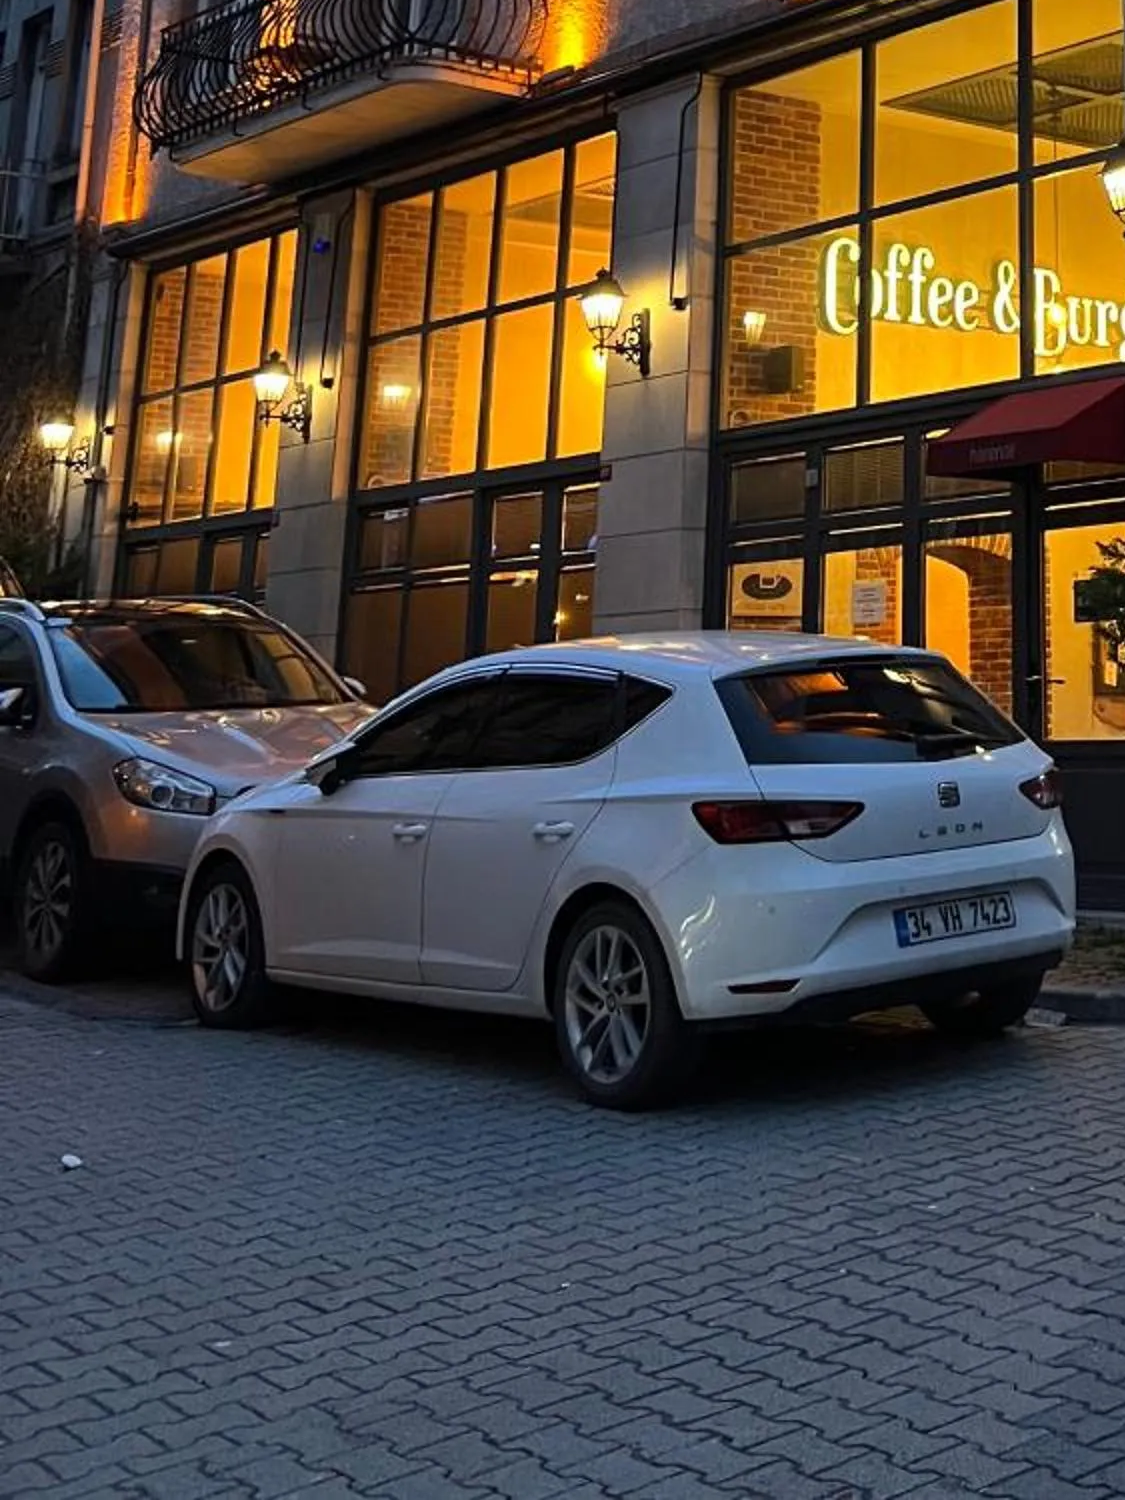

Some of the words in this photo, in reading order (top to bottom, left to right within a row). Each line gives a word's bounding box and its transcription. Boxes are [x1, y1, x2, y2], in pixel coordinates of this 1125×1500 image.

[993, 260, 1020, 333] &
[918, 820, 983, 839] LEON
[907, 909, 932, 938] 34
[969, 896, 1012, 928] 7423
